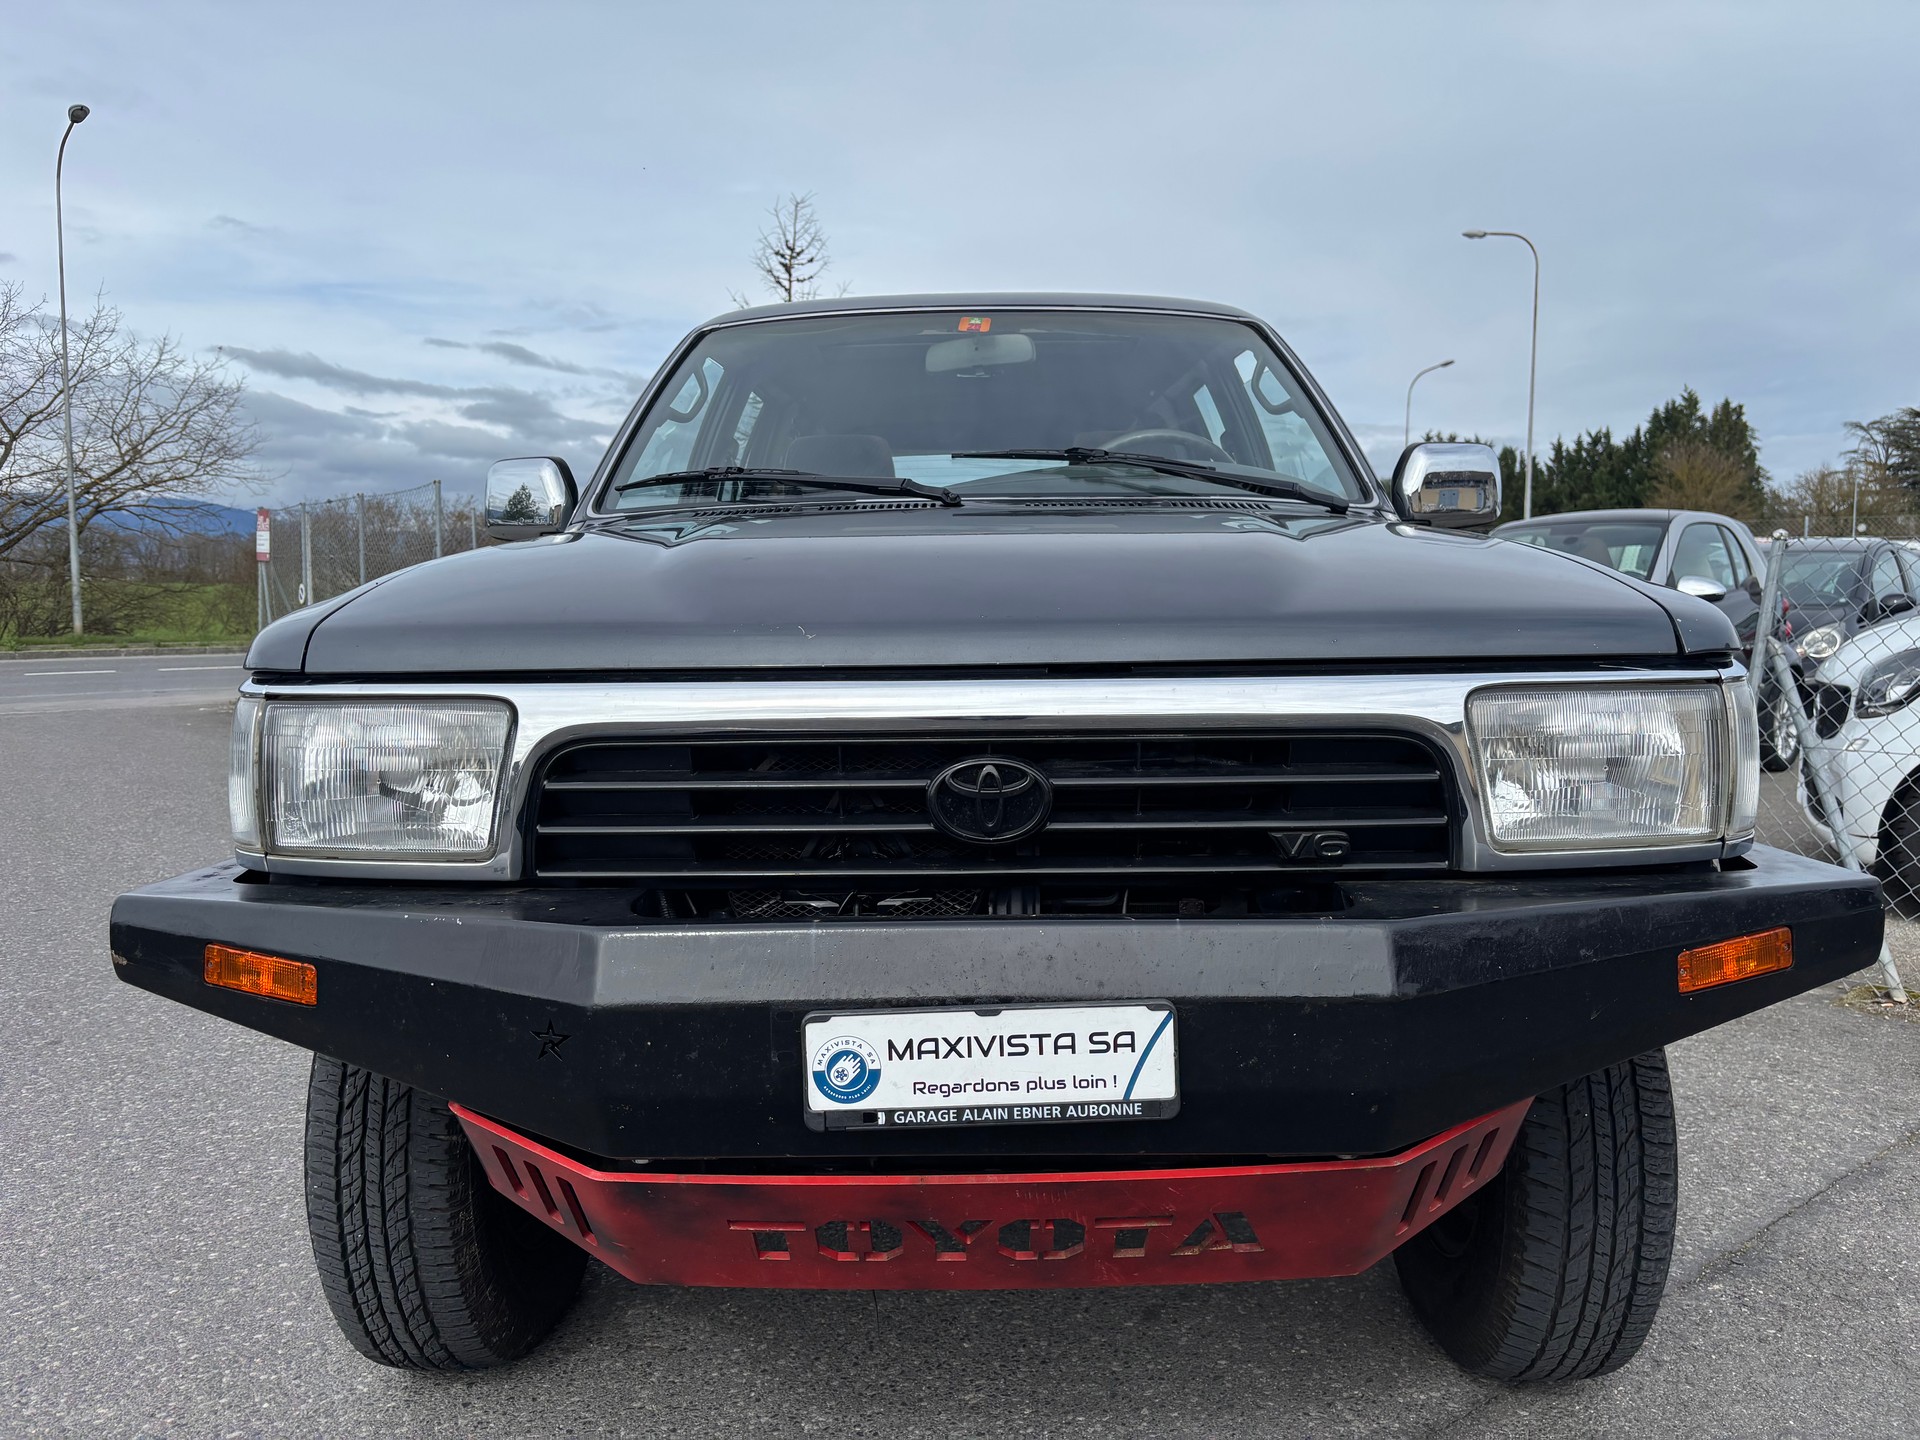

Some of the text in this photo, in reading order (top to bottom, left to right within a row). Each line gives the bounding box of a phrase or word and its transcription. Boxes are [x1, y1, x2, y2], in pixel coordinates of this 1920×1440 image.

[1268, 831, 1351, 859] V6
[817, 1039, 876, 1067] MAXIVISTA SA
[887, 1030, 1136, 1062] MAXIVISTA SA
[913, 1078, 1020, 1098] Regardons
[1026, 1076, 1067, 1094] plus
[1072, 1074, 1107, 1089] loin
[893, 1102, 1143, 1124] GARAGE ALAIN EBNER AUBONNE
[726, 1211, 1265, 1262] TOYOTA
